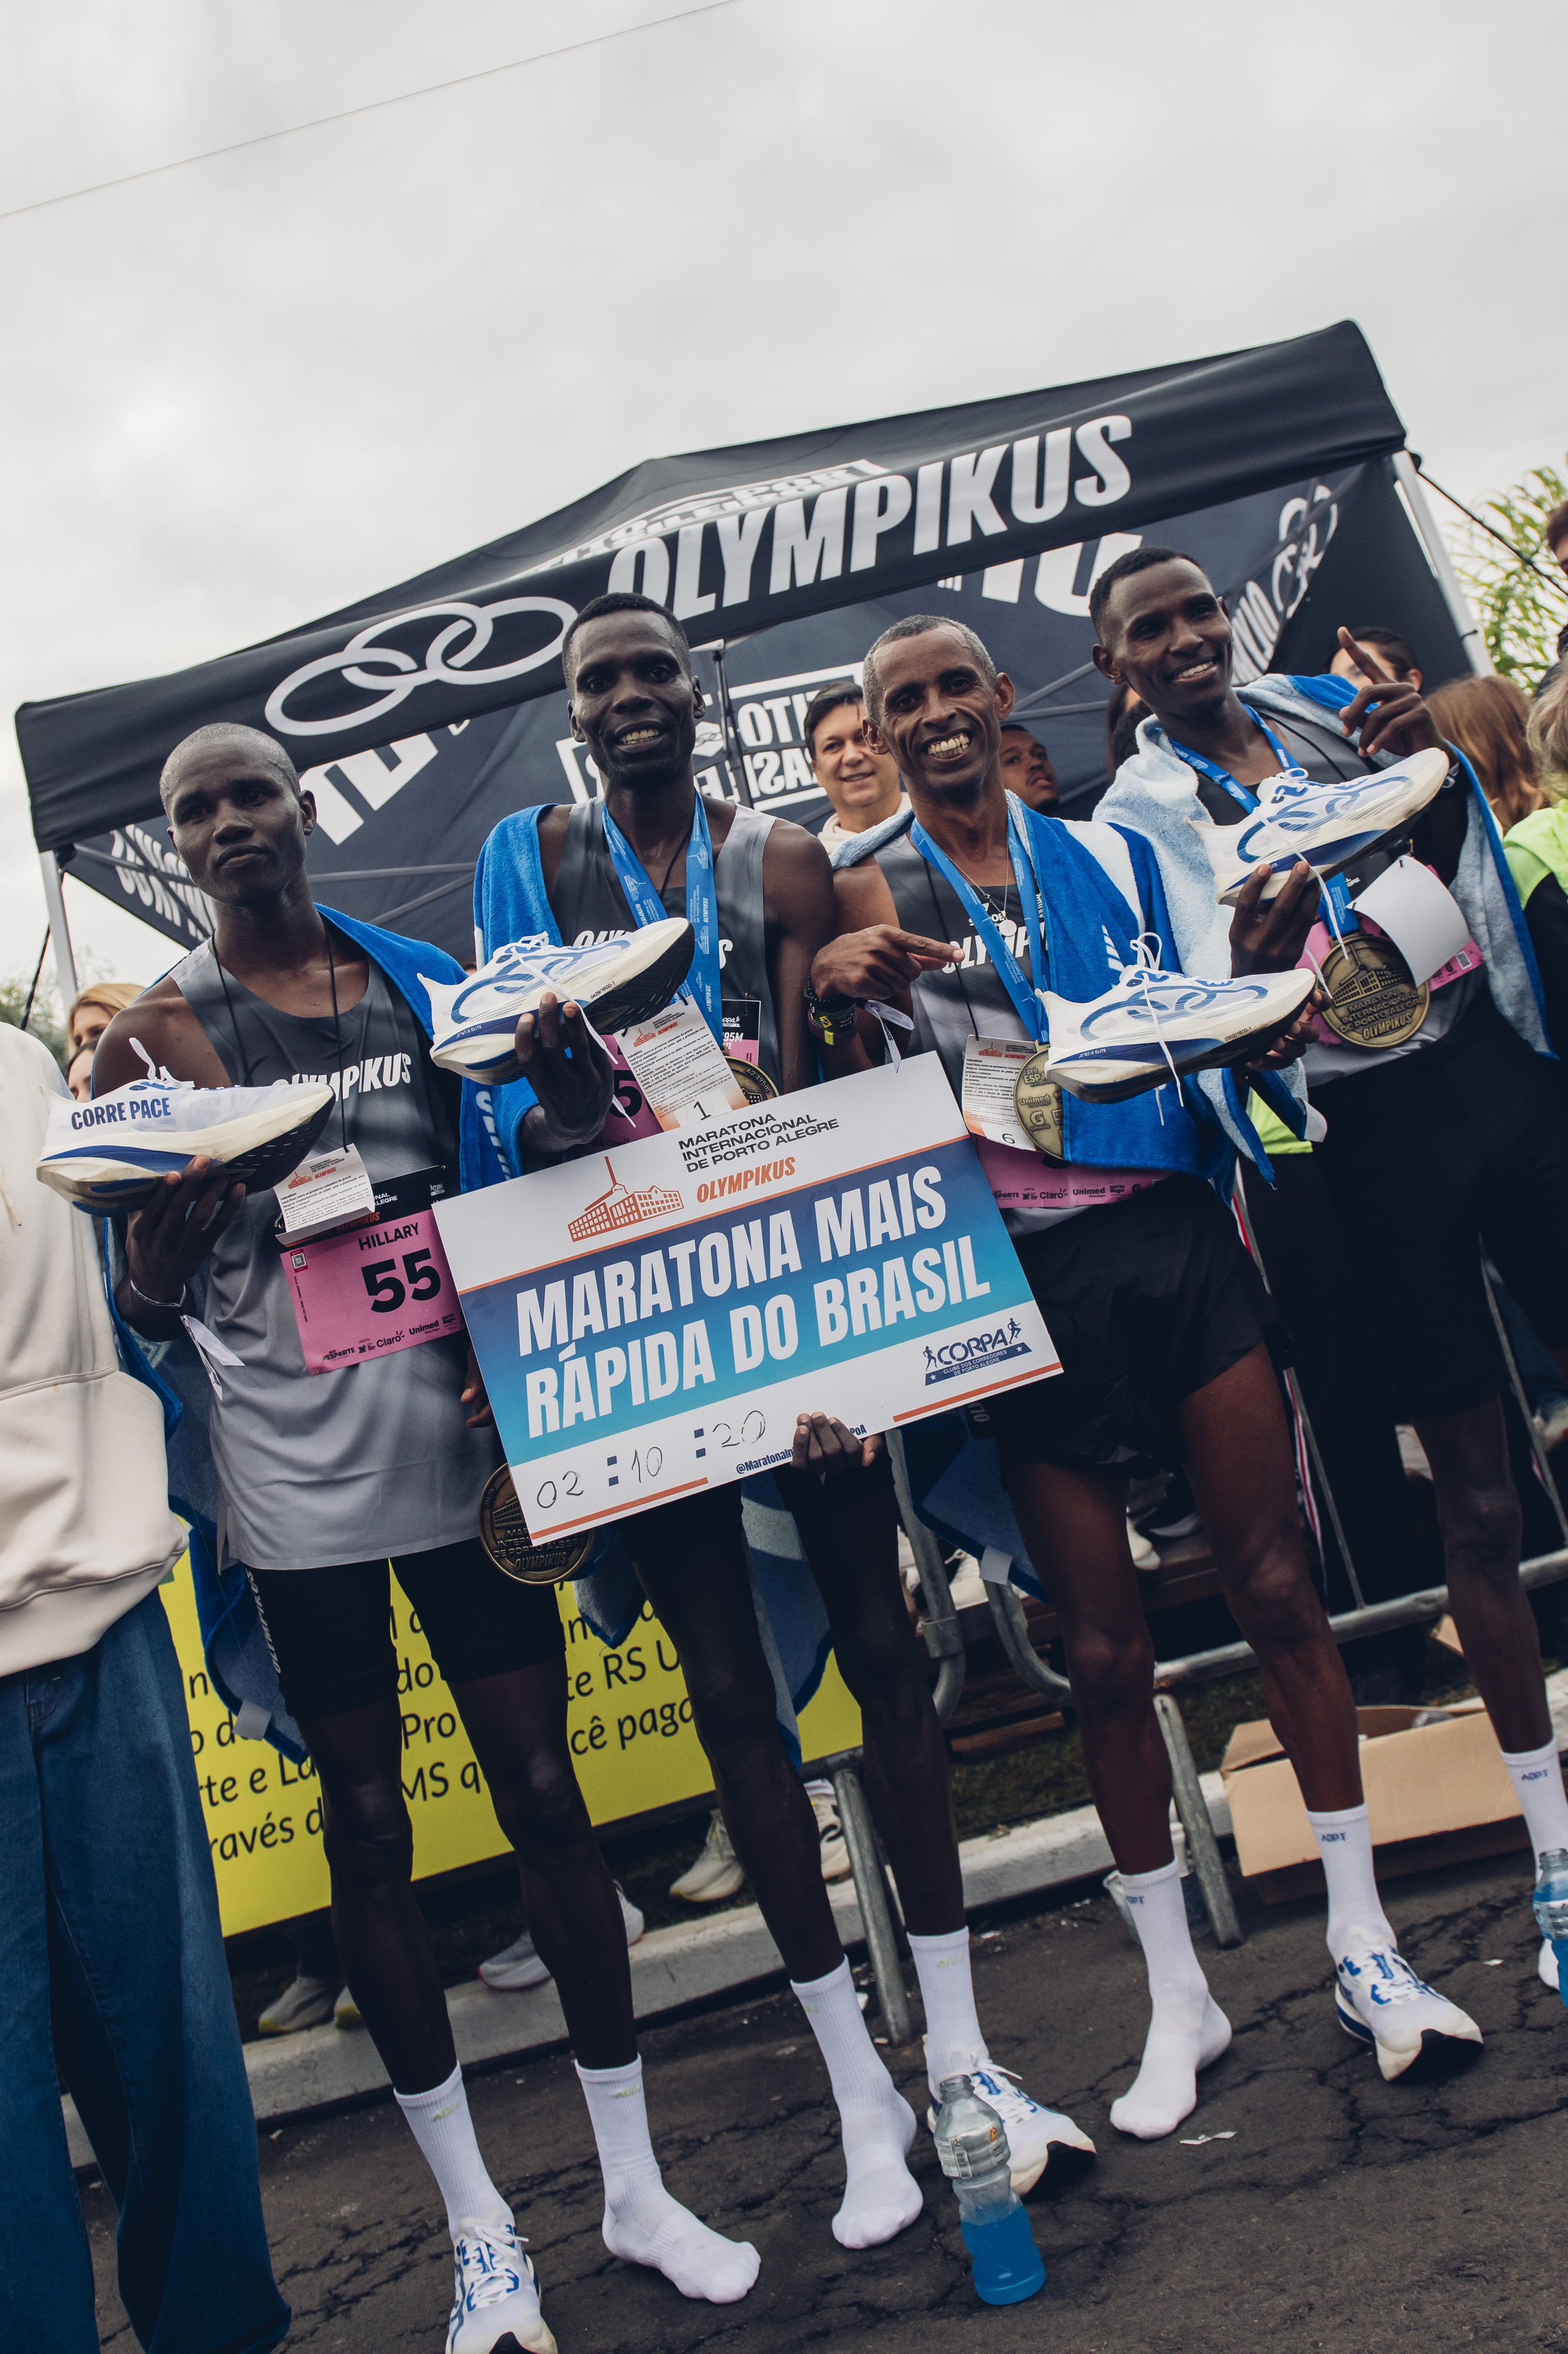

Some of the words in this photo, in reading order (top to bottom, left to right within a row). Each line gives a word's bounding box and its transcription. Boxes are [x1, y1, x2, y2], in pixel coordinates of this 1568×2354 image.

[607, 415, 1132, 622] OLYMPIKUS
[644, 905, 653, 920] PORTO
[648, 898, 660, 920] MARATONA
[1341, 990, 1419, 1023] INTERNACIONAL
[1348, 988, 1403, 1013] MARATONA
[652, 1013, 671, 1023] MARATONA
[654, 1012, 680, 1026] INTERNACIONAL
[1340, 1023, 1355, 1033] DE
[1354, 1012, 1387, 1028] PORTO
[1389, 997, 1426, 1017] ALEGRE
[1363, 1012, 1413, 1040] OLYMPIKUS
[471, 1025, 482, 1033] ELITE
[657, 1022, 678, 1035] OLYMPIKUS
[667, 1035, 680, 1043] colocados
[627, 1050, 642, 1058] PARABÉNS!
[642, 1048, 663, 1059] imediatamente
[685, 1030, 698, 1038] premiação
[746, 1069, 771, 1092] 42.195m
[693, 1101, 711, 1121] 1
[1019, 1094, 1050, 1106] Unimed
[71, 1102, 126, 1130] CORRE
[129, 1098, 171, 1119] PACE
[678, 1113, 777, 1150] MARATONA
[682, 1114, 817, 1161] INTERNACIONAL
[1002, 1133, 1016, 1144] 6
[686, 1158, 710, 1173] DE
[711, 1140, 771, 1165] PORTO
[775, 1119, 840, 1146] ALEGRE
[310, 1159, 331, 1169] MARATONA
[311, 1158, 340, 1171] INTERNACIONAL
[315, 1167, 337, 1179] OLYMPIKUS
[697, 1156, 796, 1203] OLYMPIKUS
[1040, 1189, 1064, 1200] Claro
[1073, 1186, 1106, 1195] Unimed
[358, 1222, 419, 1251] HILLARY
[515, 1210, 803, 1357] MARATONA
[818, 1165, 946, 1265] MAIS
[361, 1248, 441, 1313] 55
[409, 1320, 440, 1335] Unimed
[524, 1318, 718, 1440] RÁPIDA
[729, 1294, 800, 1374] DO
[813, 1234, 991, 1348] BRASIL
[377, 1332, 403, 1348] Claro
[937, 1328, 1008, 1365] CORPA
[943, 1365, 961, 1374] CLUBE
[960, 1361, 972, 1370] DOS
[972, 1349, 1008, 1365] CORREDORES
[961, 1363, 980, 1374] PORTO
[980, 1357, 1001, 1369] ALEGRE
[537, 1471, 584, 1508] 02
[631, 1446, 663, 1484] 10
[713, 1410, 767, 1448] 20
[493, 1549, 507, 1558] DE
[514, 1551, 568, 1571] OLYMPIKUS
[603, 1646, 647, 1690] RS
[249, 1767, 268, 1794] e
